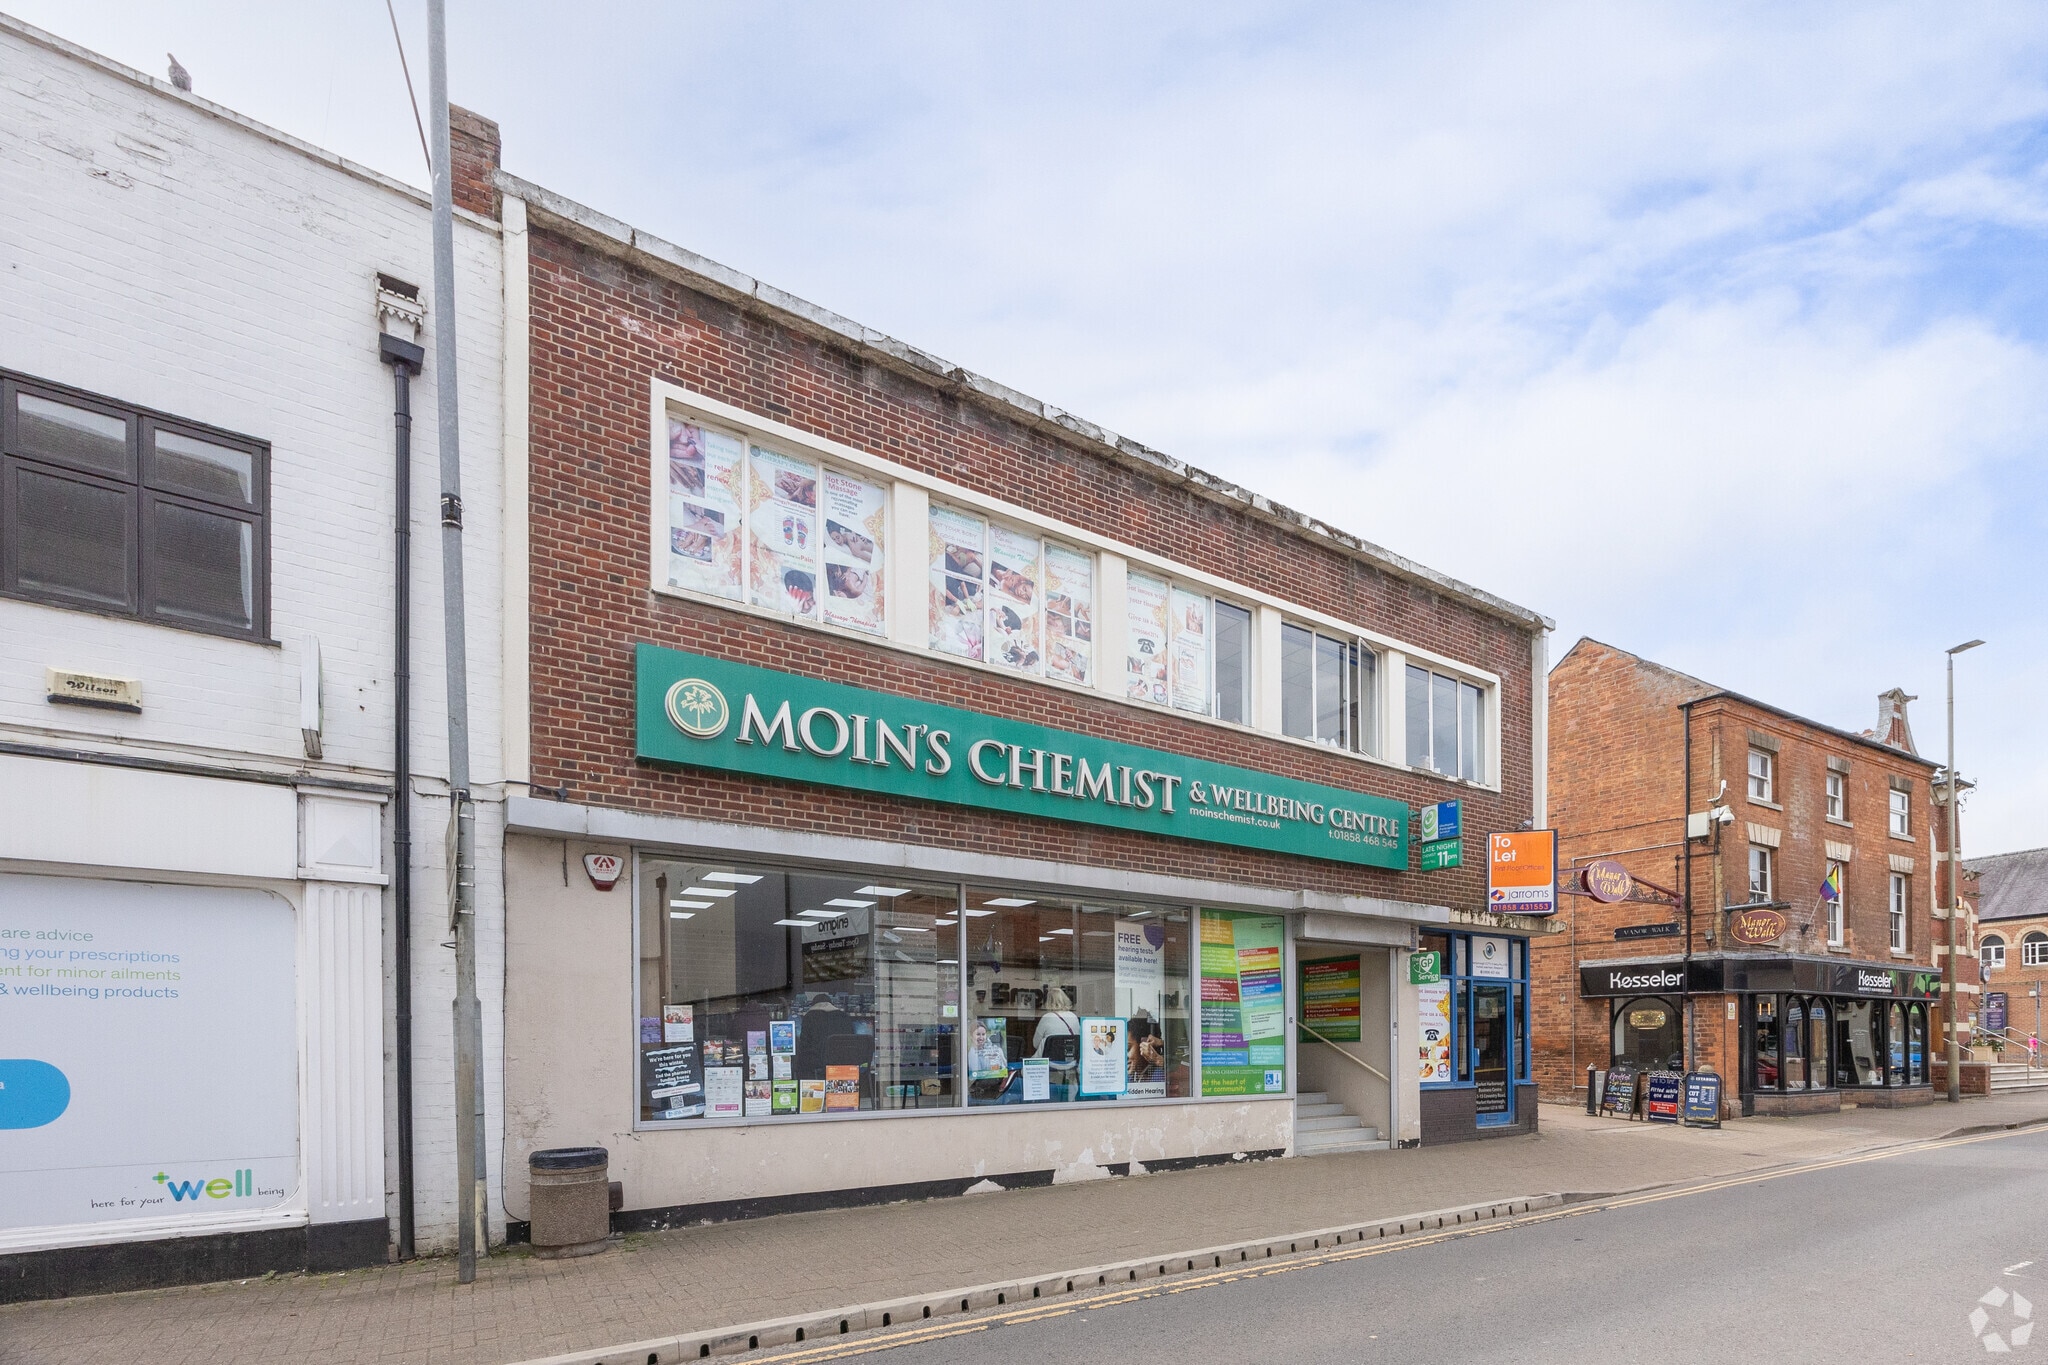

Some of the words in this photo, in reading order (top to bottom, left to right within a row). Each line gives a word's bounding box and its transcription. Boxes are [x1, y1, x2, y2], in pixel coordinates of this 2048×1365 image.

[825, 475, 840, 485] Hot
[840, 479, 862, 491] Stone
[828, 482, 859, 497] Massage
[824, 610, 849, 622] Massage
[1127, 612, 1142, 623] Give
[66, 680, 118, 694] Wilson
[735, 693, 951, 777] MOIN'S
[968, 739, 1182, 814] CHEMIST
[1189, 781, 1207, 803] &
[1209, 783, 1325, 825] WELLBEING
[1328, 808, 1400, 839] CENTRE
[1189, 806, 1281, 831] moinschemist.co.uk
[1362, 835, 1379, 846] 468
[1381, 837, 1399, 850] 545
[1422, 845, 1436, 854] LATE
[1436, 841, 1458, 851] NIGHT
[1494, 836, 1511, 848] To
[1437, 850, 1457, 866] 11pm
[1494, 849, 1517, 862] Let
[1508, 889, 1549, 900] jarroms
[1739, 915, 1772, 929] Manor
[35, 929, 94, 942] advice
[1651, 926, 1671, 934] WALK
[1745, 922, 1778, 939] Walk
[1118, 933, 1141, 944] FREE
[24, 949, 65, 961] your
[69, 950, 180, 963] prescriptions
[1118, 945, 1139, 954] hearing
[1118, 955, 1143, 963] available
[1420, 958, 1433, 968] GP
[27, 965, 53, 977] for
[57, 966, 107, 979] minor
[110, 968, 181, 981] ailments
[1418, 973, 1439, 981] Service
[1609, 969, 1684, 989] Kesseler
[1858, 969, 1893, 988] Kesseler
[0, 983, 9, 995] &
[13, 984, 99, 999] wellbeing
[104, 986, 179, 1000] products
[671, 1069, 691, 1077] pharmacy
[1145, 1087, 1165, 1096] Hearing
[1213, 1085, 1246, 1093] community
[91, 1199, 115, 1209] here
[120, 1197, 136, 1208] for
[139, 1197, 165, 1209] your
[257, 1187, 285, 1198] being
